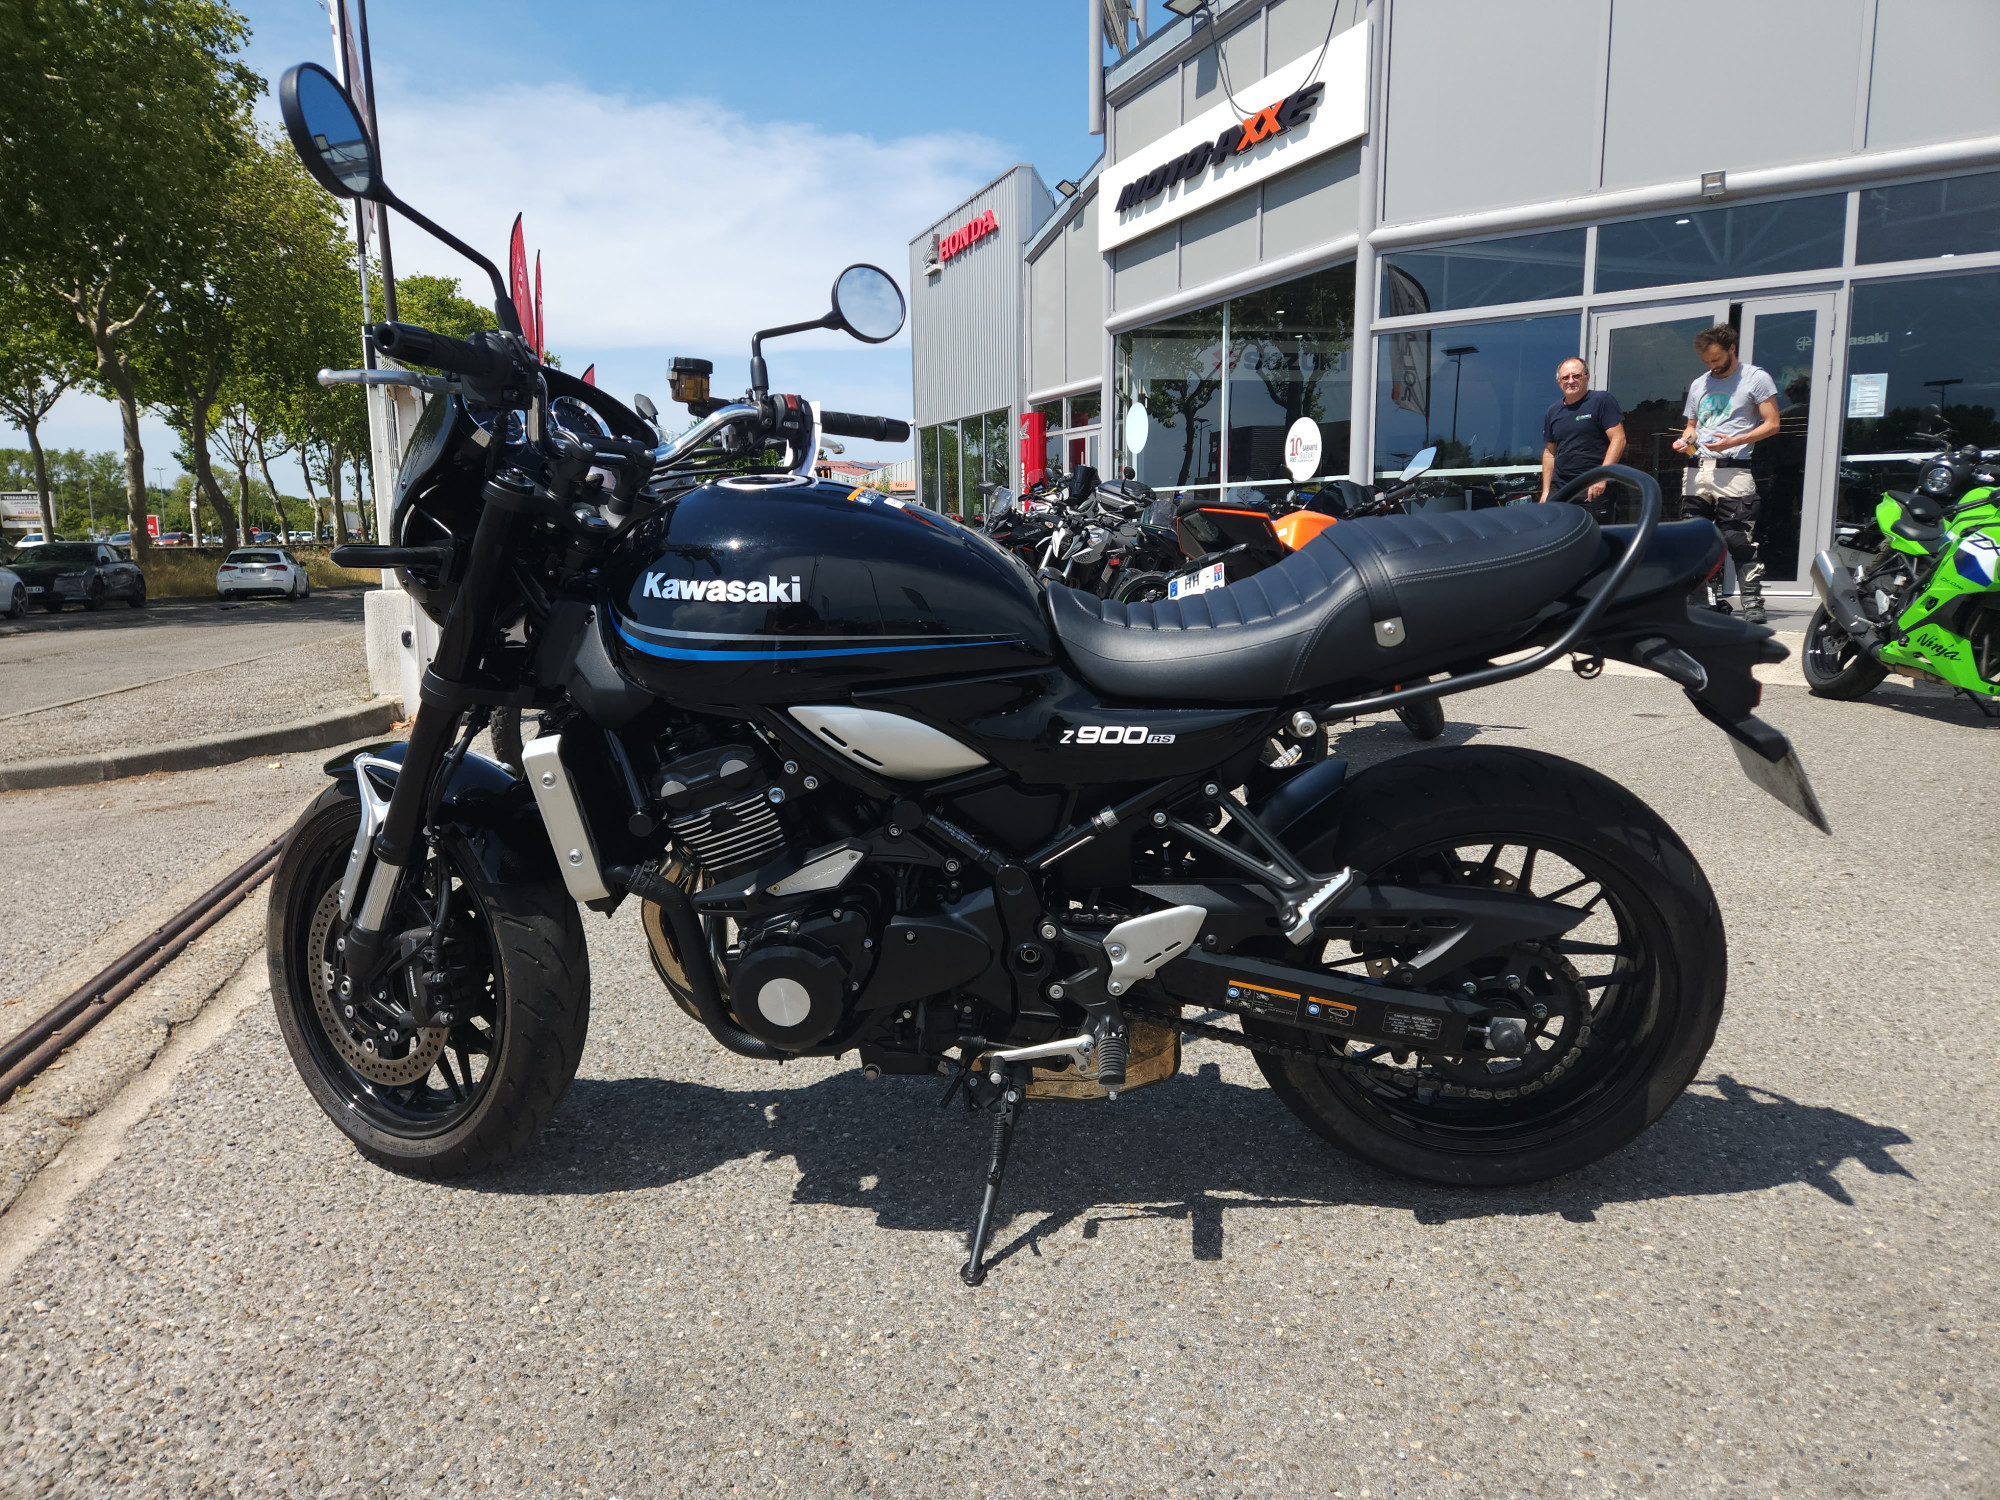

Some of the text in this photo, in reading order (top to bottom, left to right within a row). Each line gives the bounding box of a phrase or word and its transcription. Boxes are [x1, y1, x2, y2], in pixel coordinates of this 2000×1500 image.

[939, 209, 999, 262] HONDA
[1848, 332, 1889, 346] asaki
[1243, 351, 1348, 371] SUZUKI
[642, 571, 801, 603] Kawasaki
[1916, 633, 1962, 661] Ninja
